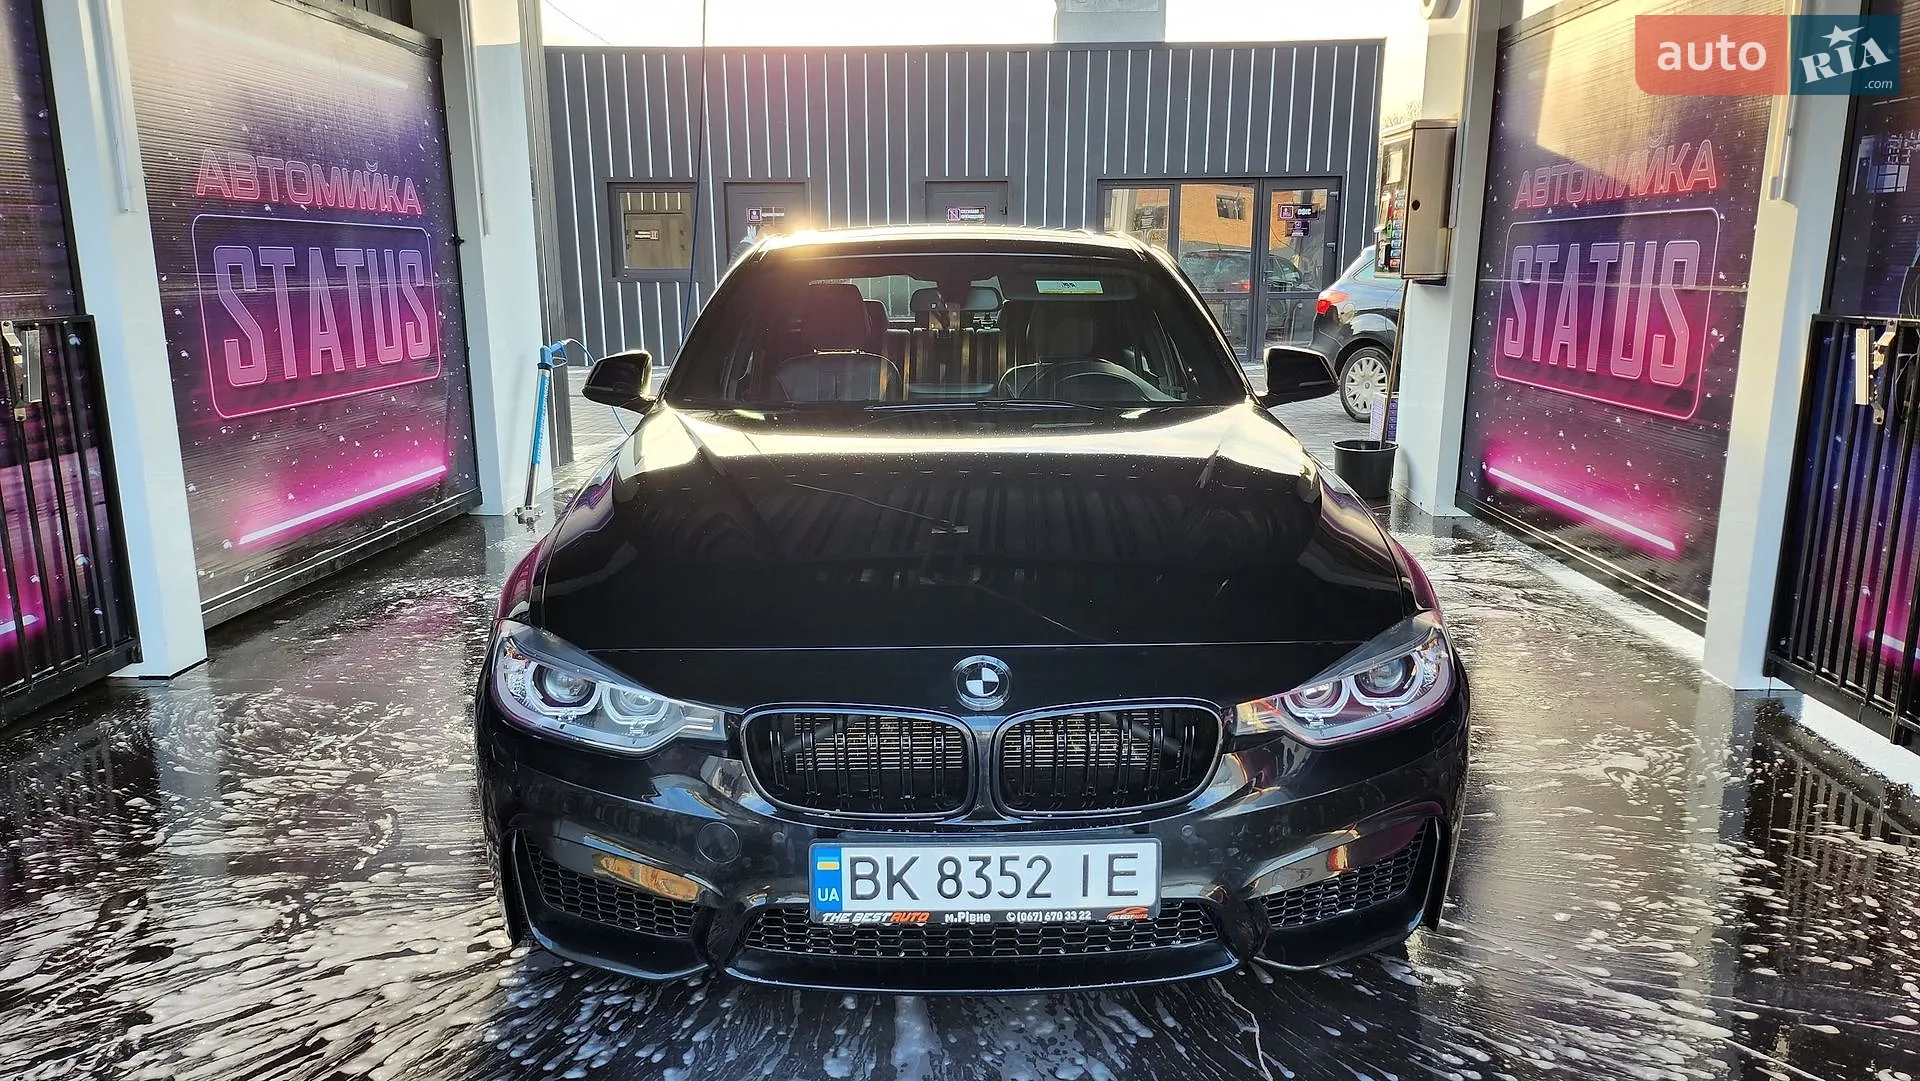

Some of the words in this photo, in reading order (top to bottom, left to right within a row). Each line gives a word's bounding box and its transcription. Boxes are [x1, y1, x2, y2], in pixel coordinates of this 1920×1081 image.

[196, 149, 423, 215] АВТОМИЙКА
[1512, 133, 1718, 210] АВТОМИЙКА
[213, 245, 431, 387] STATUS
[1503, 240, 1701, 388] STATUS
[817, 887, 840, 903] UA
[849, 855, 920, 901] BK
[936, 853, 1052, 900] 8352
[822, 912, 853, 923] THE
[1016, 911, 1043, 922] (067)
[1044, 910, 1063, 921] 670
[1064, 910, 1077, 920] 33
[1078, 910, 1092, 920] 22
